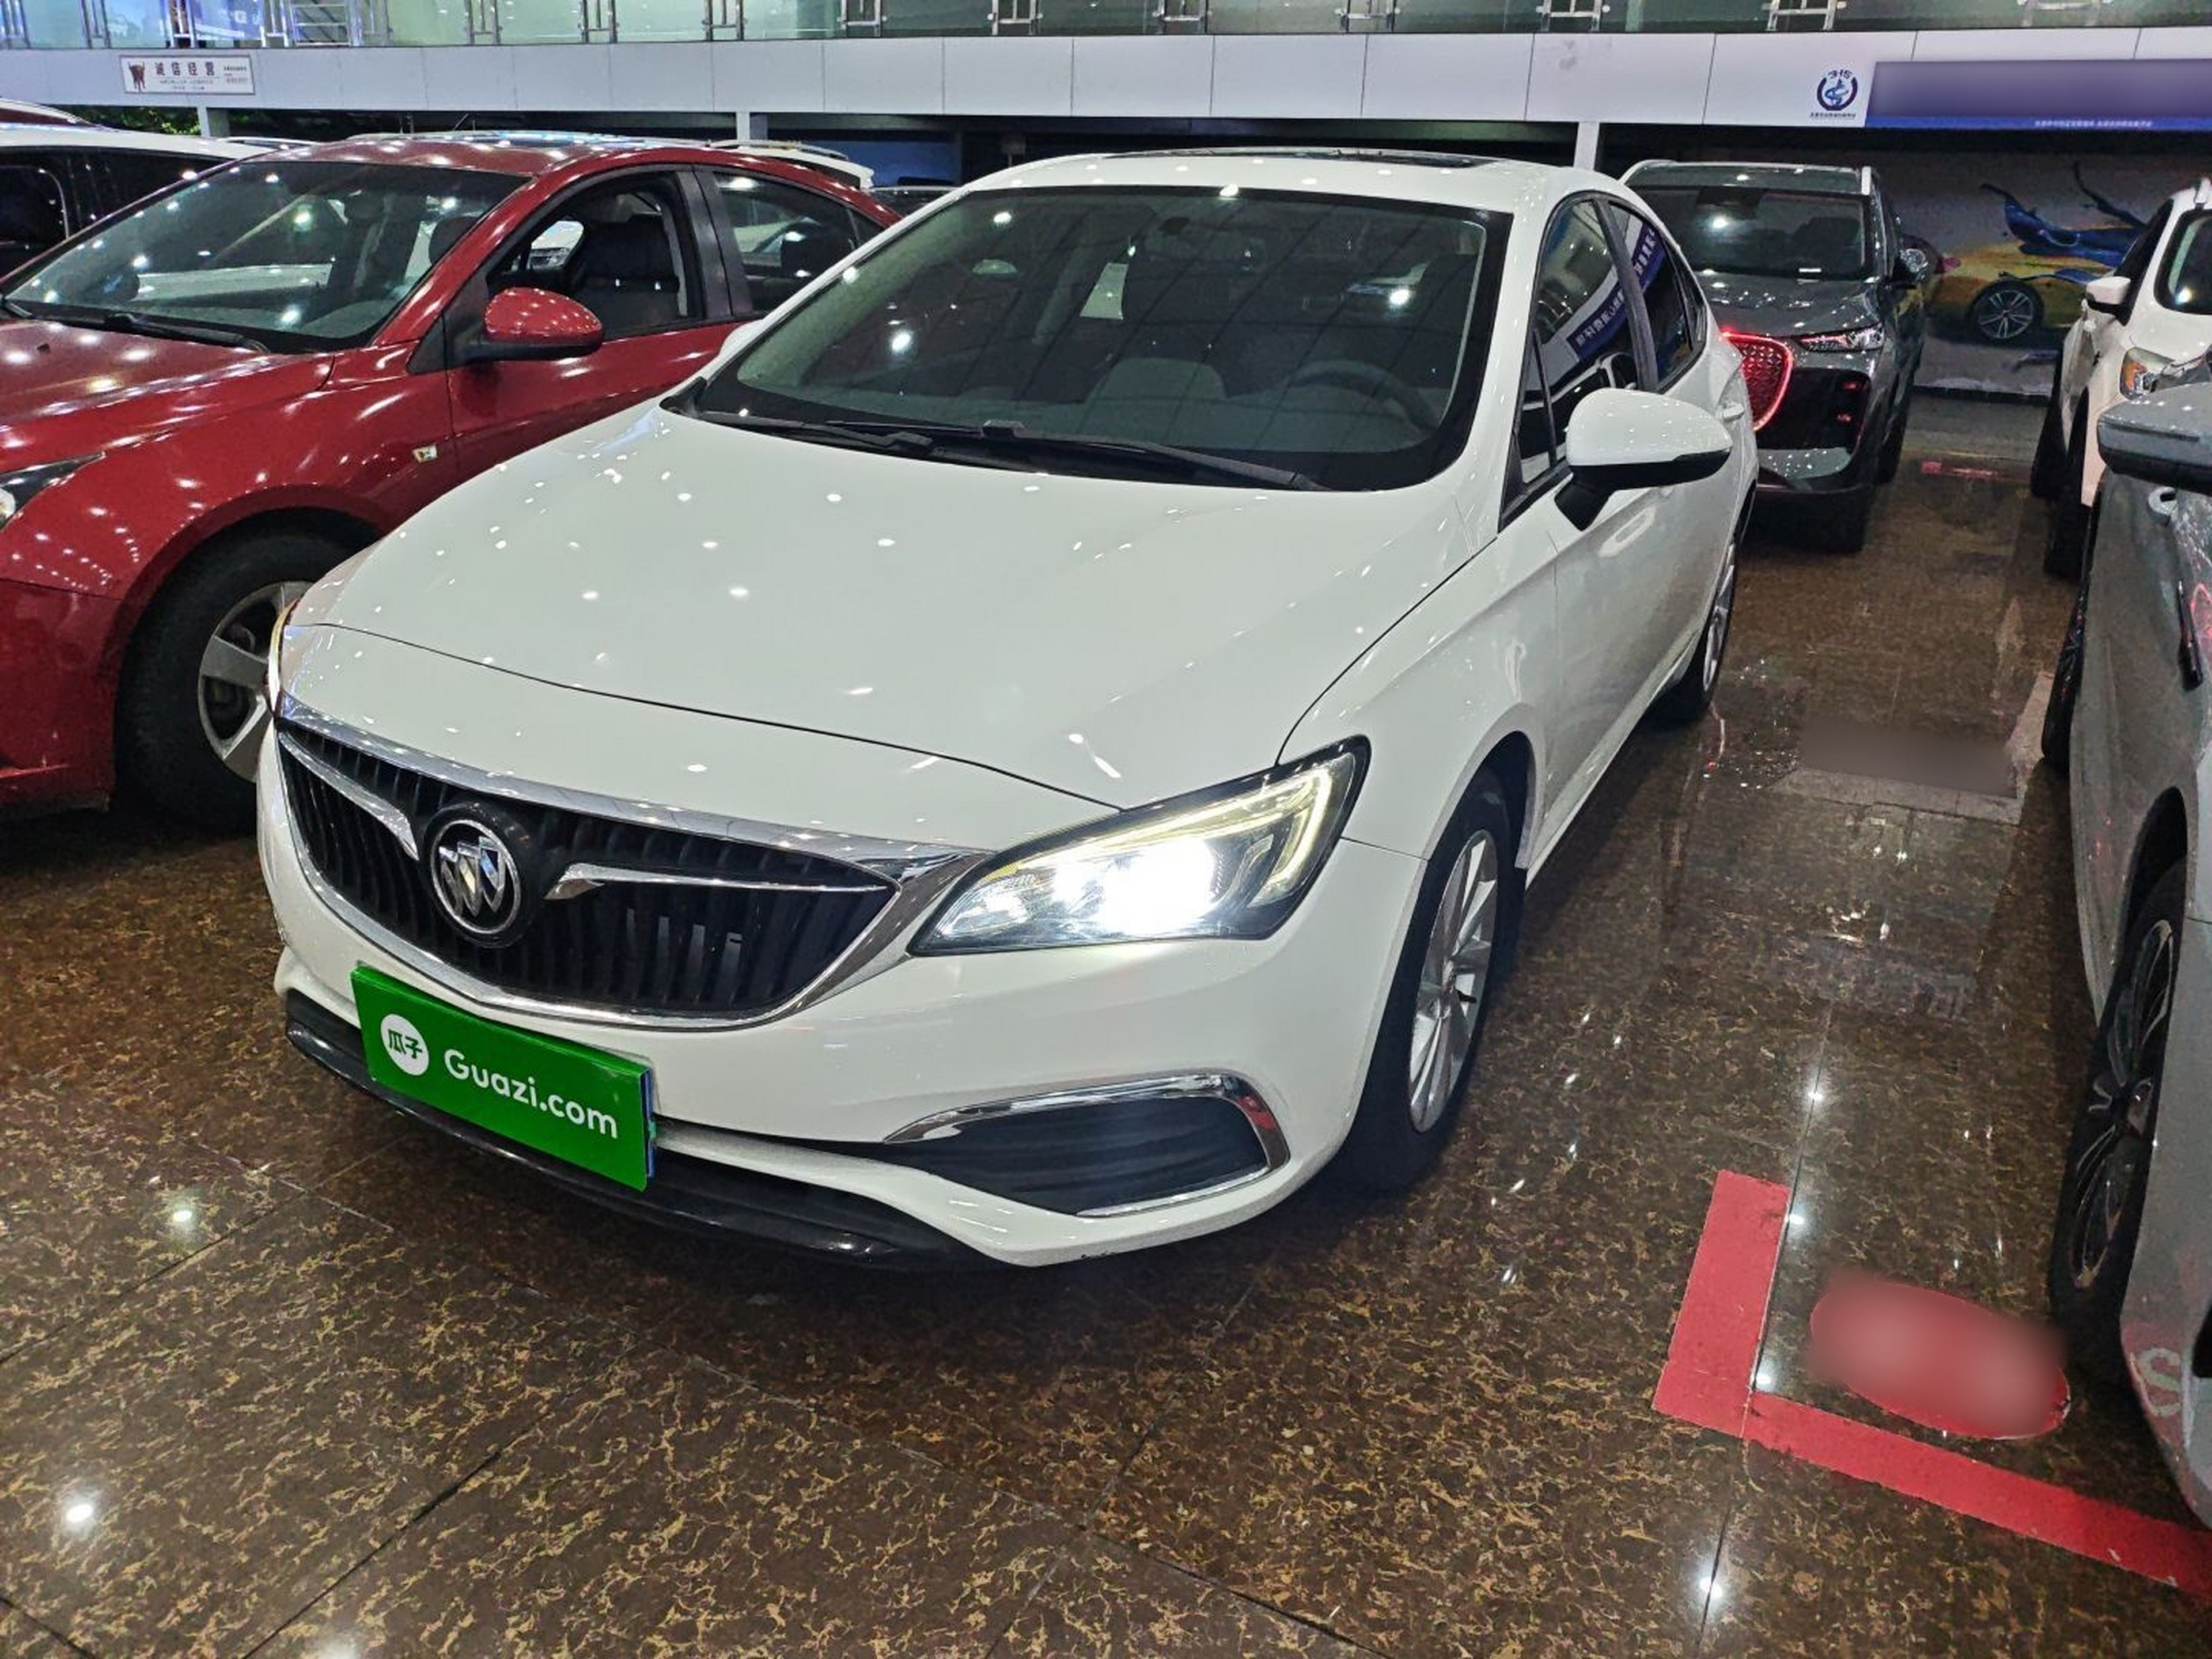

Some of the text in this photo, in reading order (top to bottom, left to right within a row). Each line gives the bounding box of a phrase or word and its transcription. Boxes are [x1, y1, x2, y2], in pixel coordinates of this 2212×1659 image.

[154, 61, 214, 75] 诚信经营
[388, 1029, 618, 1139] 瓜子 Guazi.com
